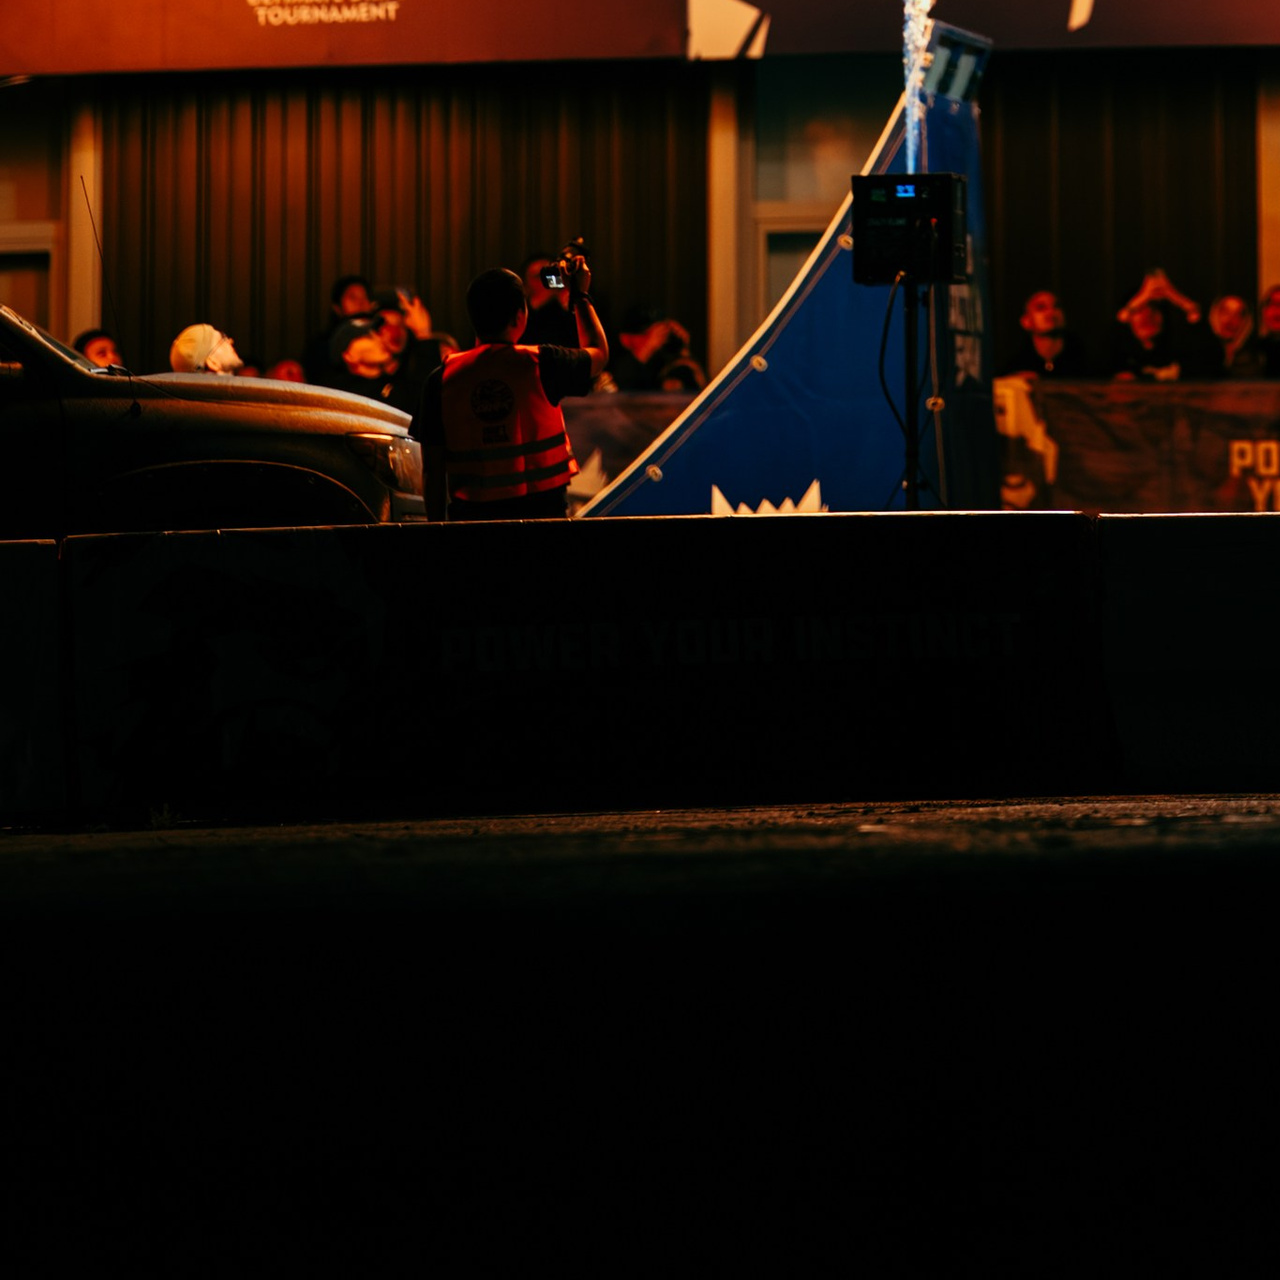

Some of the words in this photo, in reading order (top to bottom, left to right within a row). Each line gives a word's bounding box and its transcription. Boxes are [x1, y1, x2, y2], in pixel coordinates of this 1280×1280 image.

[254, 1, 399, 26] TOURNAMENT
[440, 624, 622, 672] POWER
[642, 619, 774, 666] YOUR
[794, 612, 1022, 661] INSTINCT
